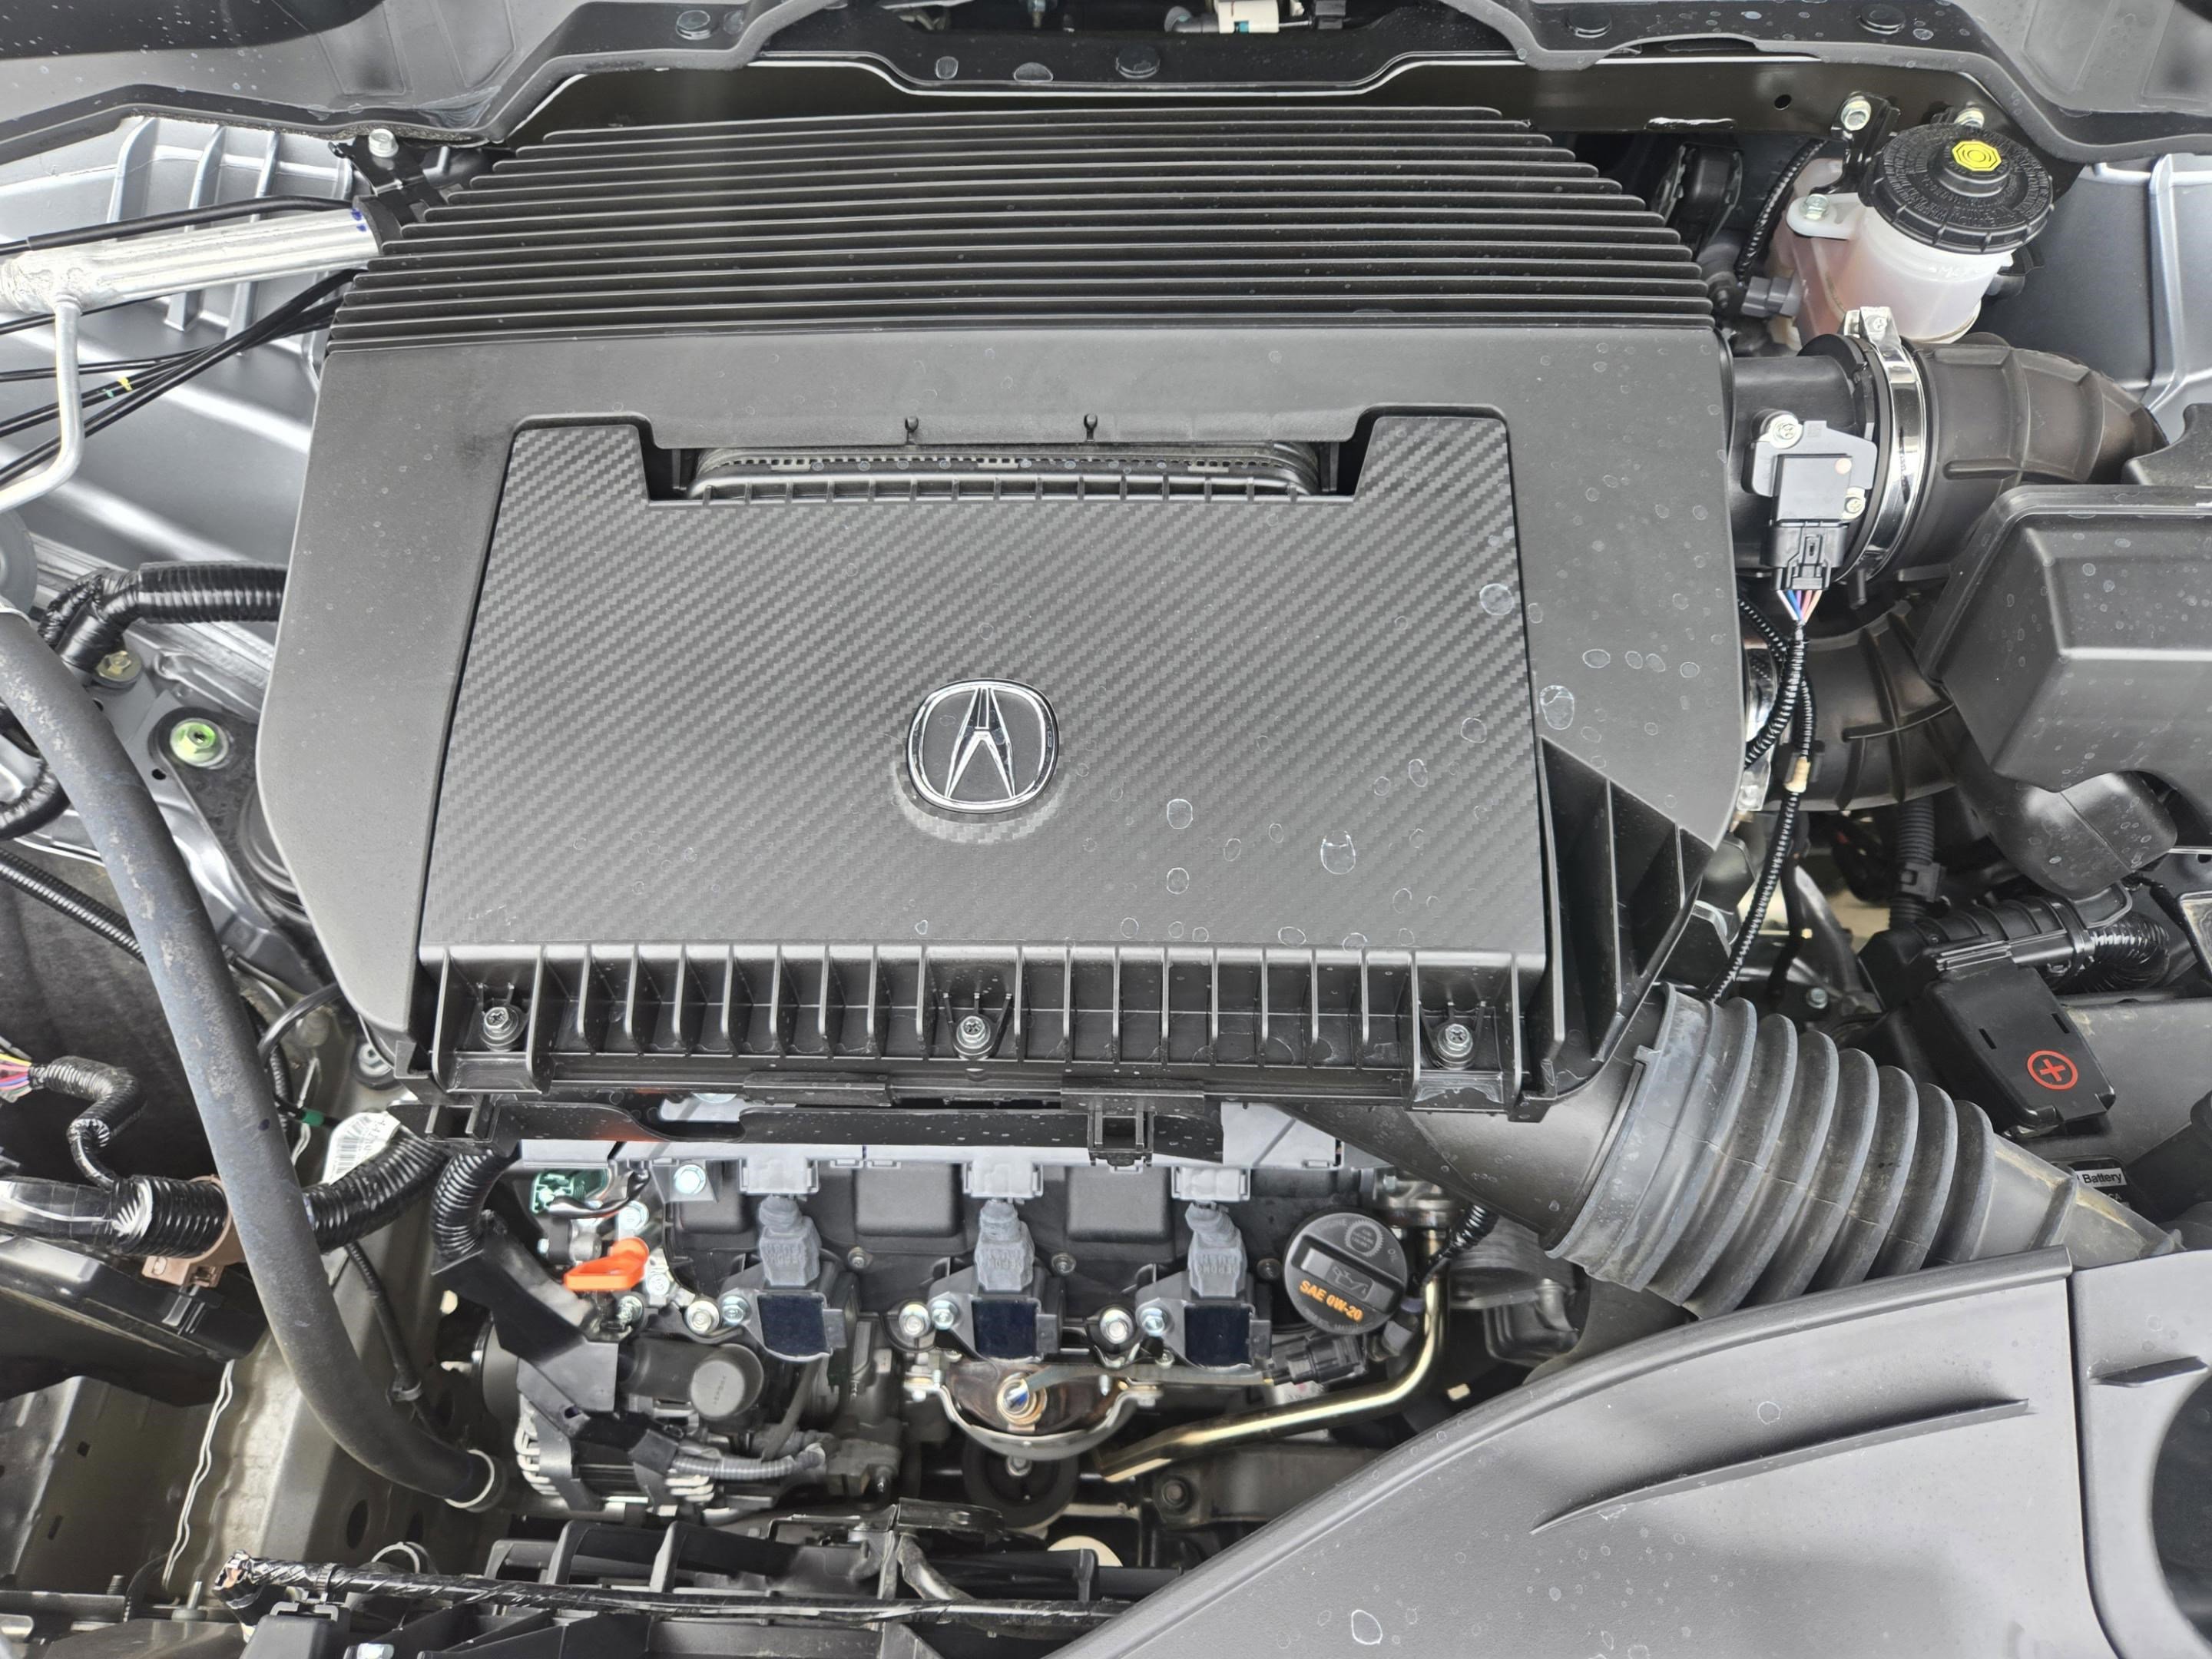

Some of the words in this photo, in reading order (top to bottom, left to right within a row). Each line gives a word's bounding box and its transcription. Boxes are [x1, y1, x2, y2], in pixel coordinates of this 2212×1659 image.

[2081, 1173, 2122, 1184] Battery
[1299, 1280, 1327, 1303] SAE
[1326, 1293, 1364, 1323] 0W-20
